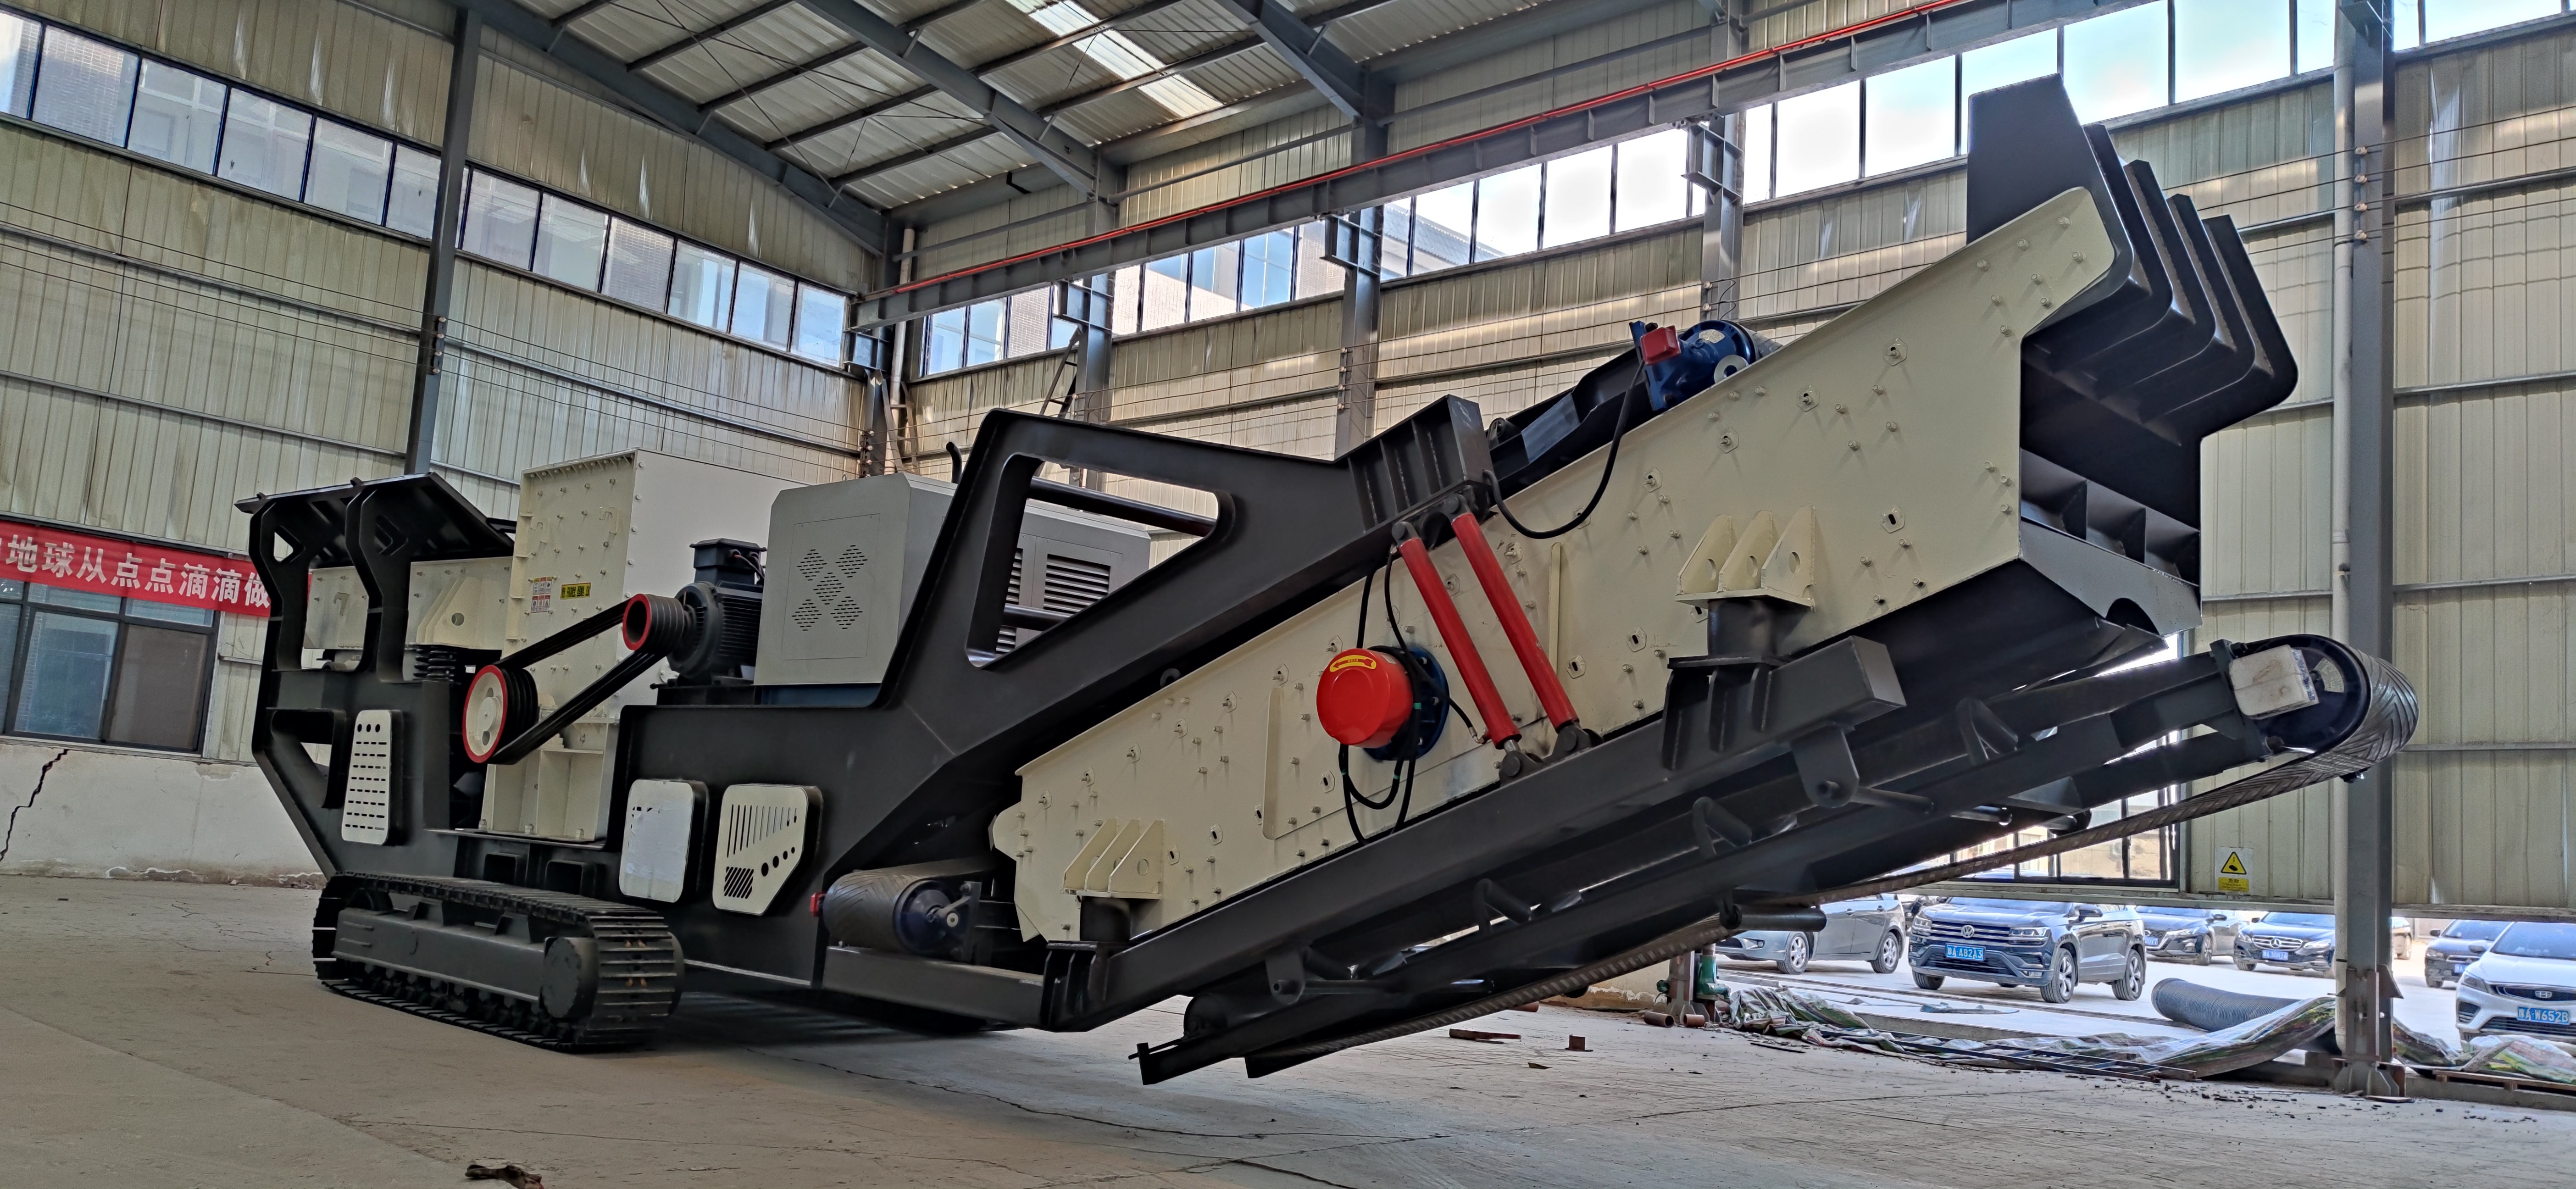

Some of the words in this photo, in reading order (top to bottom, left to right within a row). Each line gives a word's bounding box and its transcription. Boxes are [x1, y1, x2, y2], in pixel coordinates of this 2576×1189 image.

[0, 534, 270, 608] 地球从点点滴滴做
